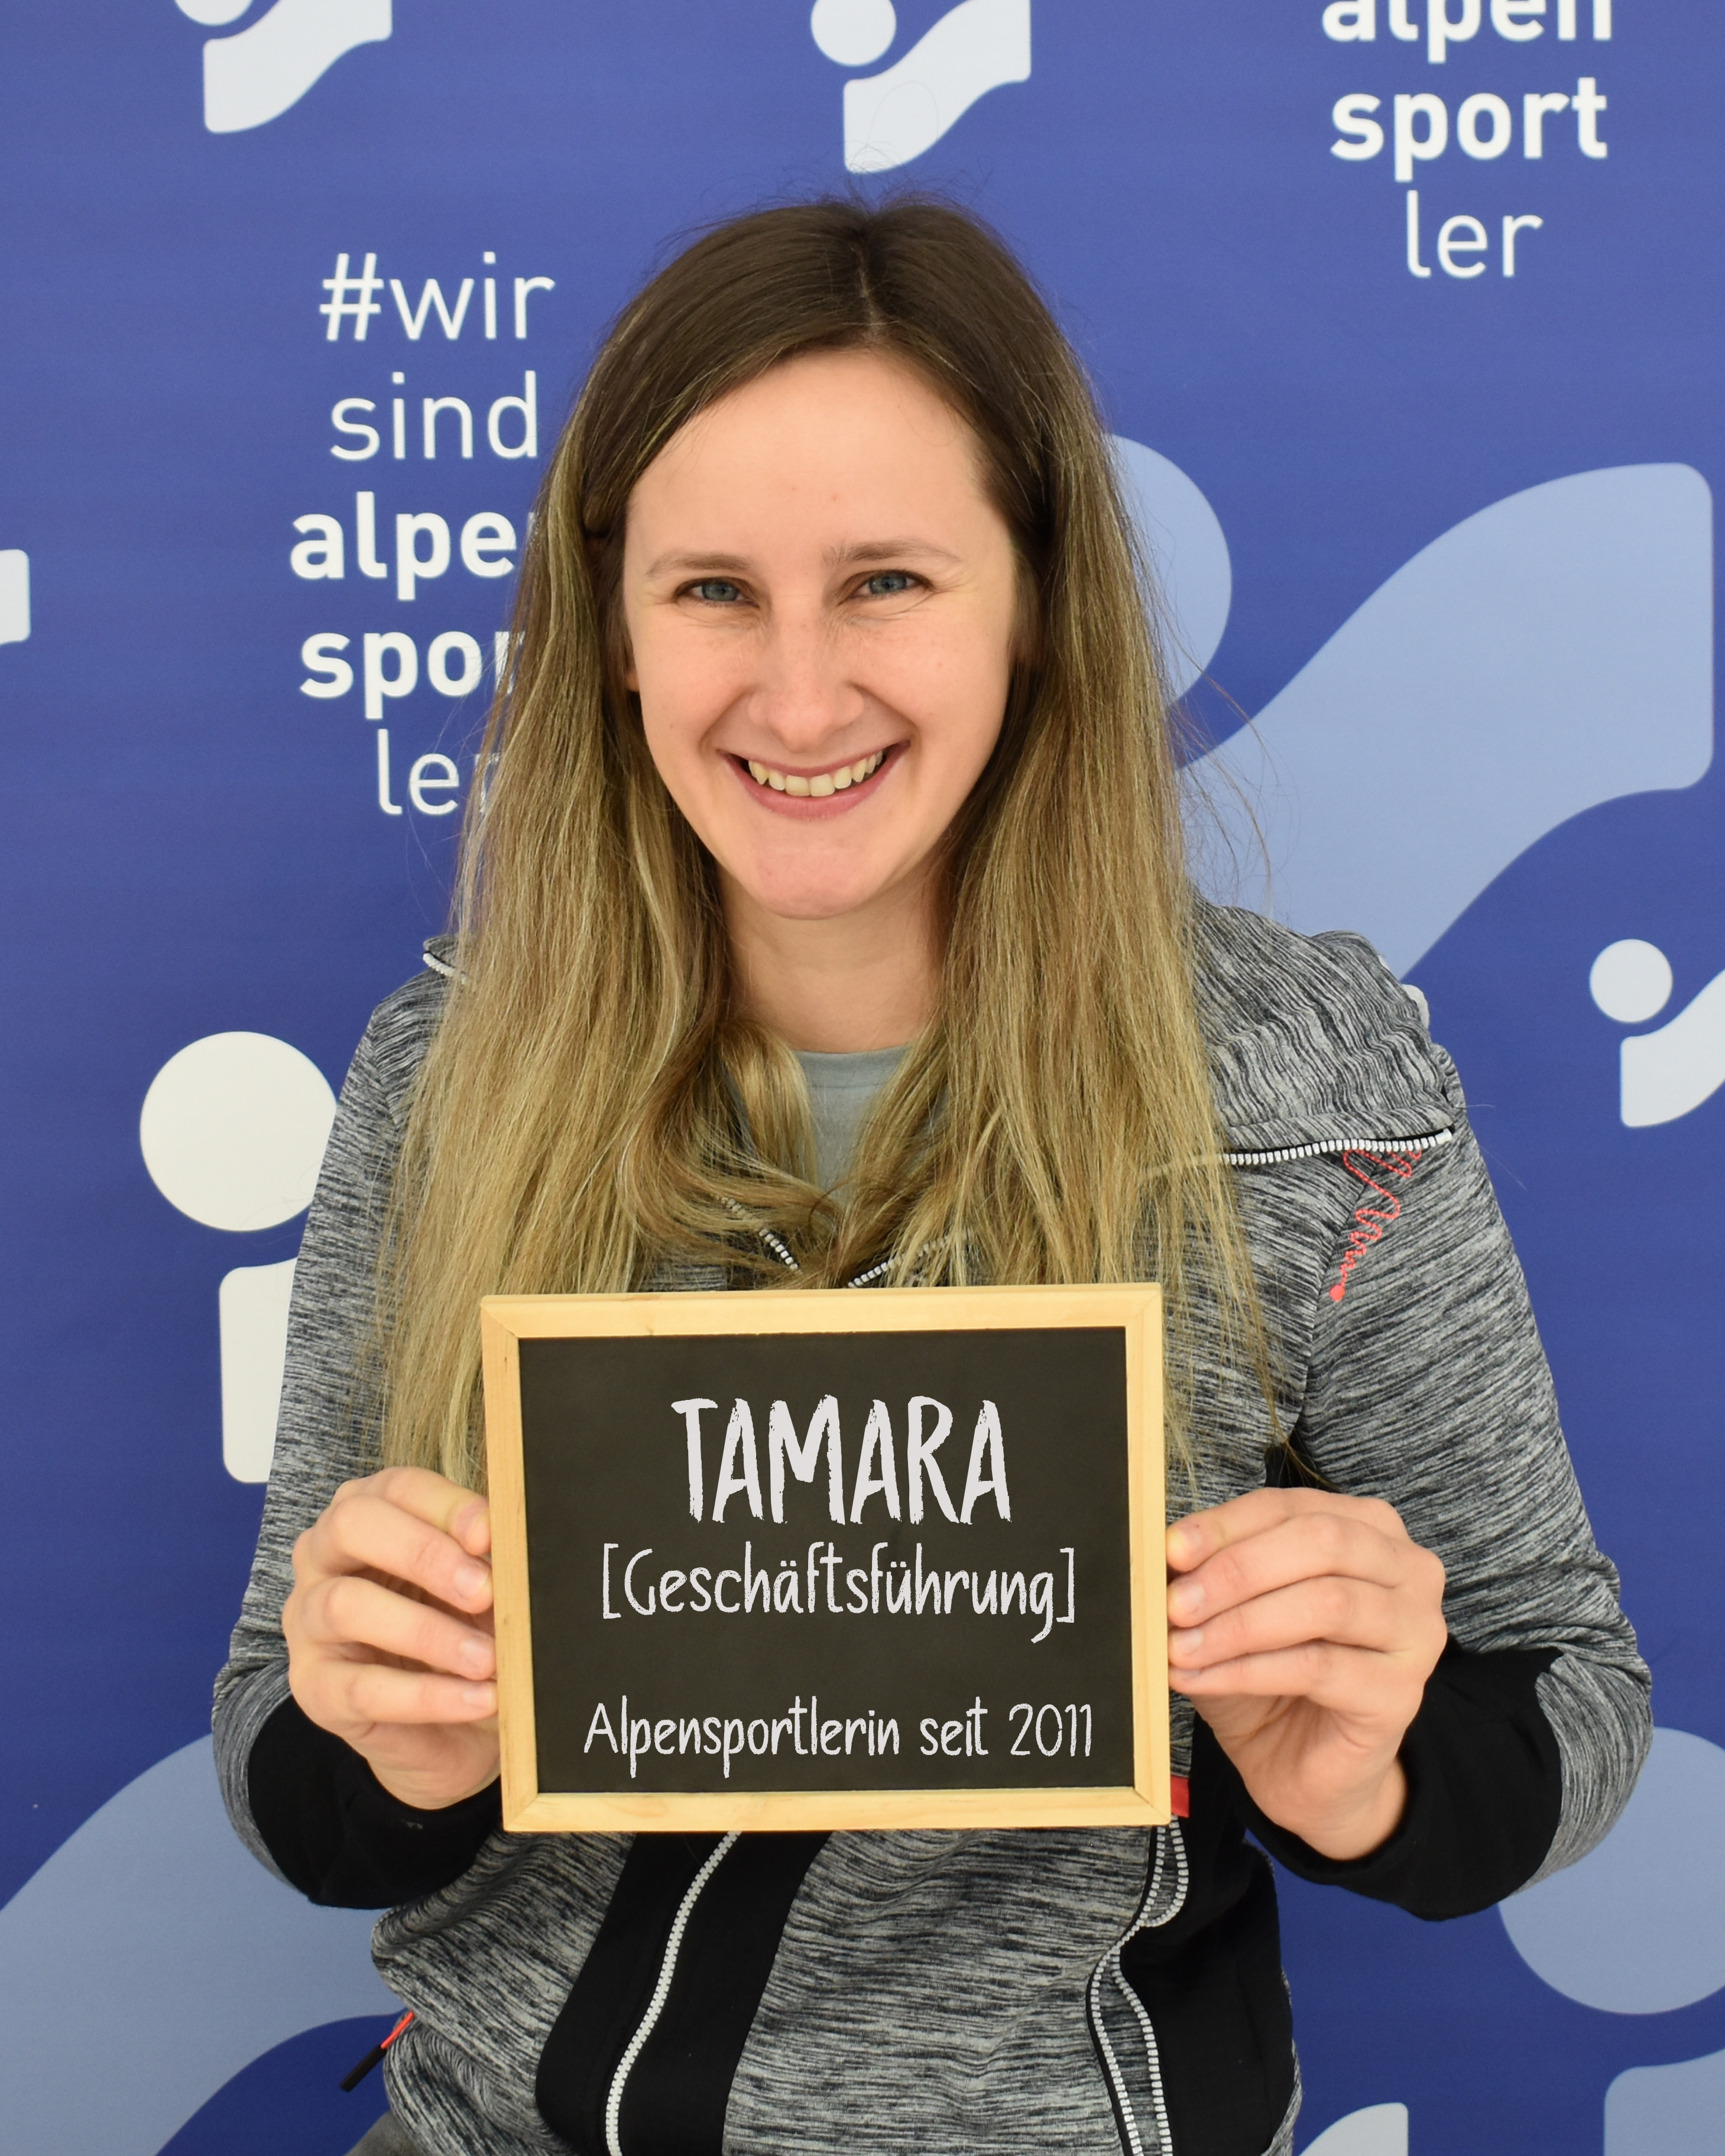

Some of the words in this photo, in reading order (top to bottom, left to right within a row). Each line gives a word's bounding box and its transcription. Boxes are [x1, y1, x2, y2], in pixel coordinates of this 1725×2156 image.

[1330, 77, 1608, 182] sport
[1406, 190, 1544, 278] ler
[319, 251, 555, 341] #wir
[330, 370, 538, 461] sind
[290, 491, 535, 601] alpe
